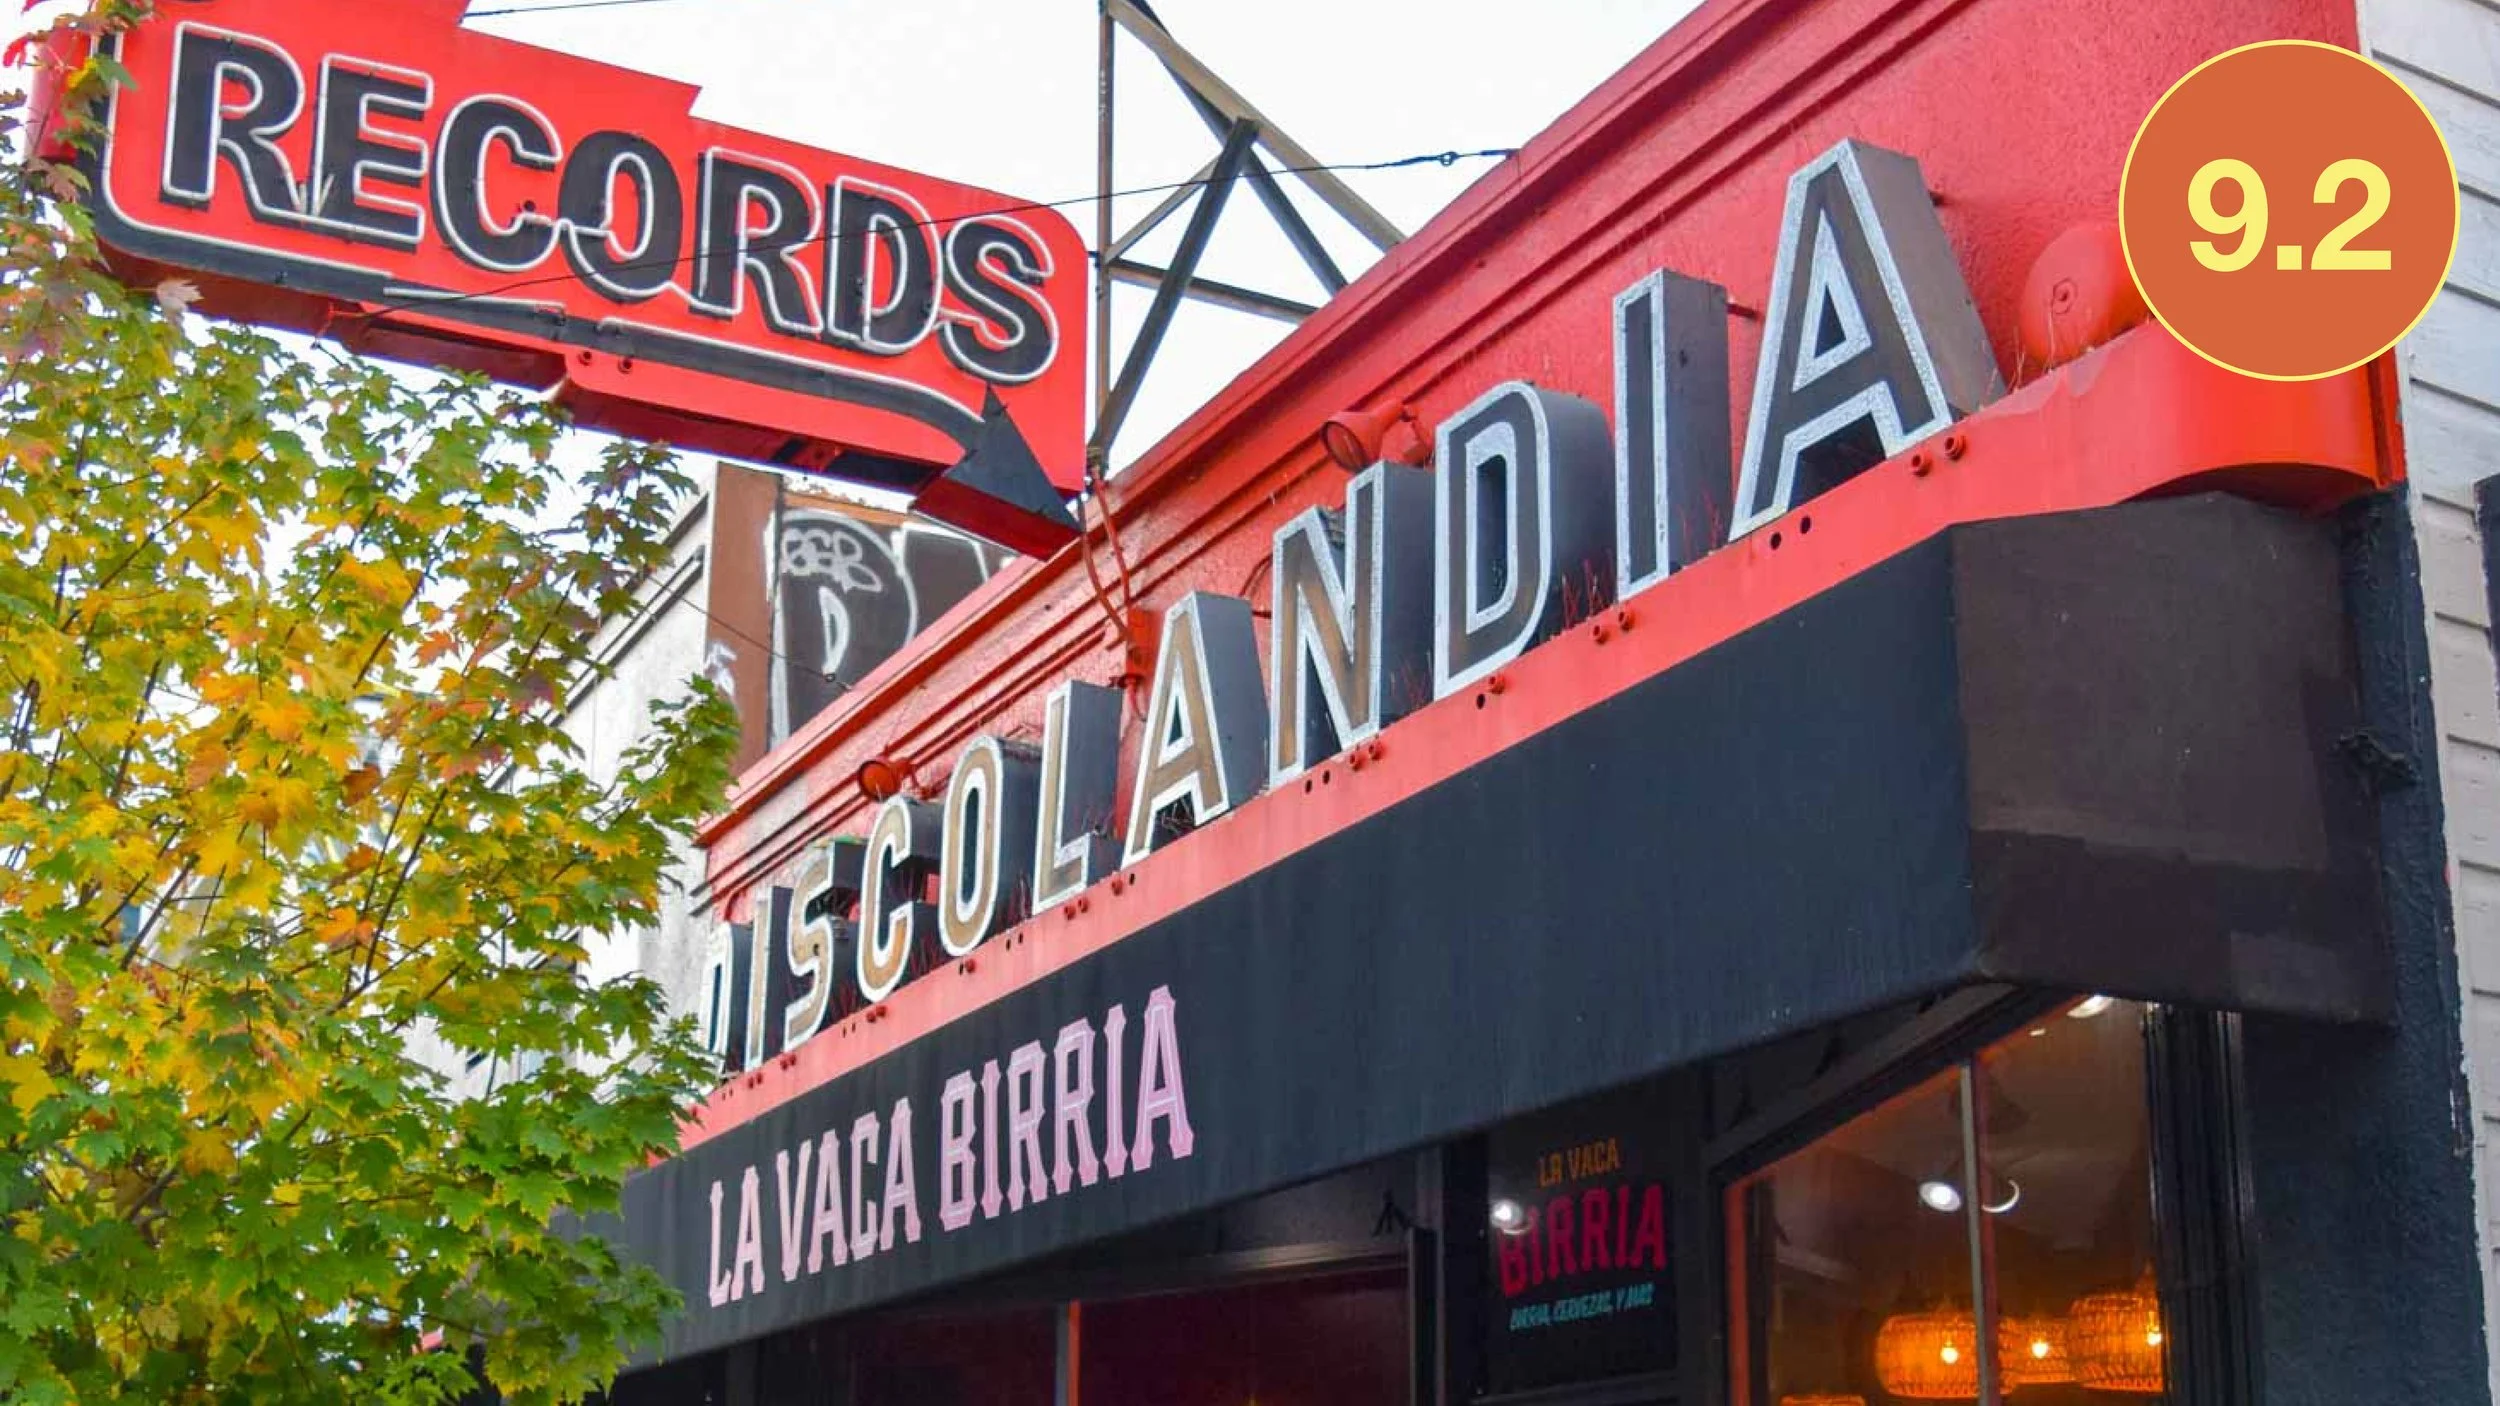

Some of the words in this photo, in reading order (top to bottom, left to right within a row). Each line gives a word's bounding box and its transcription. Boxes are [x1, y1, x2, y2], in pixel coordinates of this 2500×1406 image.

[161, 20, 1059, 385] RECORDS
[699, 138, 1985, 1077] DISCOLANDIA
[709, 1165, 764, 1307] LA
[777, 1097, 921, 1283] VACA
[939, 984, 1194, 1232] BIRRIA
[1497, 1183, 1666, 1298] BIRRIA
[1539, 1154, 1561, 1188] LA
[1567, 1137, 1621, 1180] VACA
